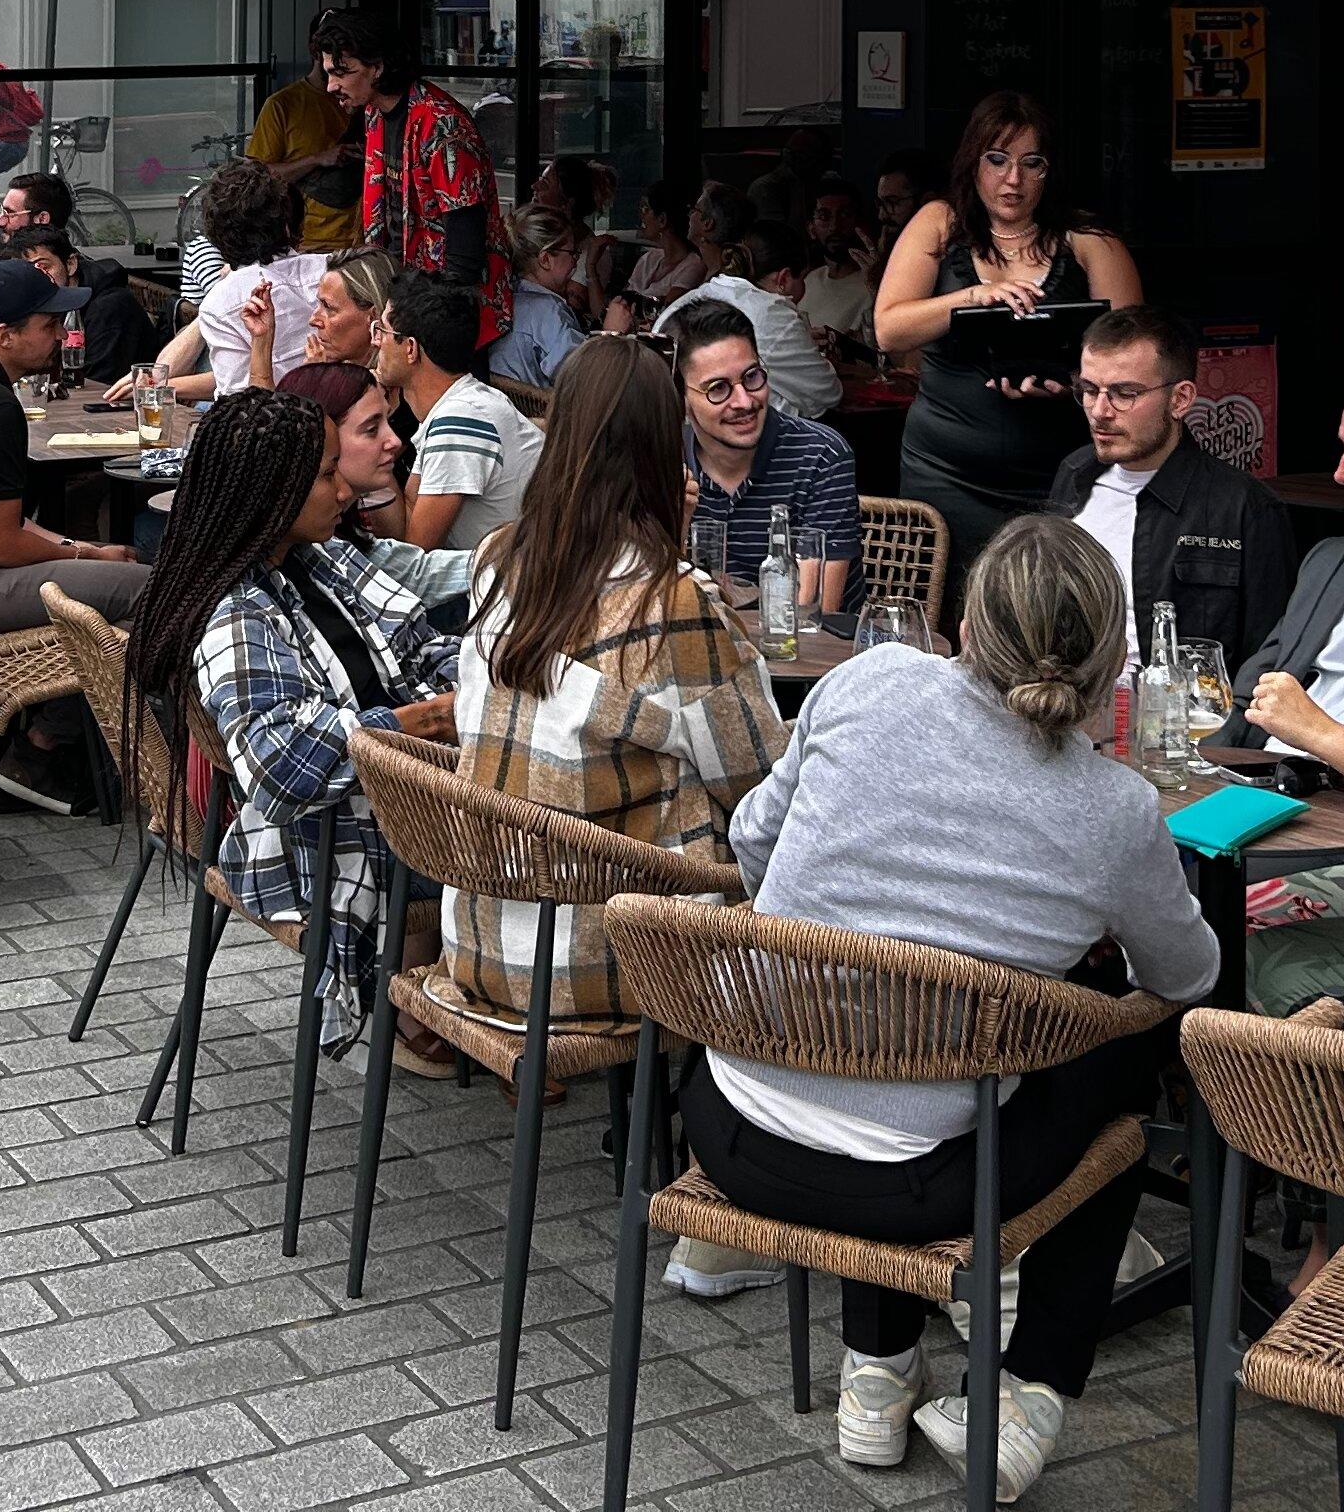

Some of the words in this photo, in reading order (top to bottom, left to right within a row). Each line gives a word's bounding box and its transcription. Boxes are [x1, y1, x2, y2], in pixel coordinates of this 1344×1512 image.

[1207, 401, 1236, 432] LES
[1176, 535, 1207, 548] PEPE
[1208, 537, 1242, 550] JEANS
